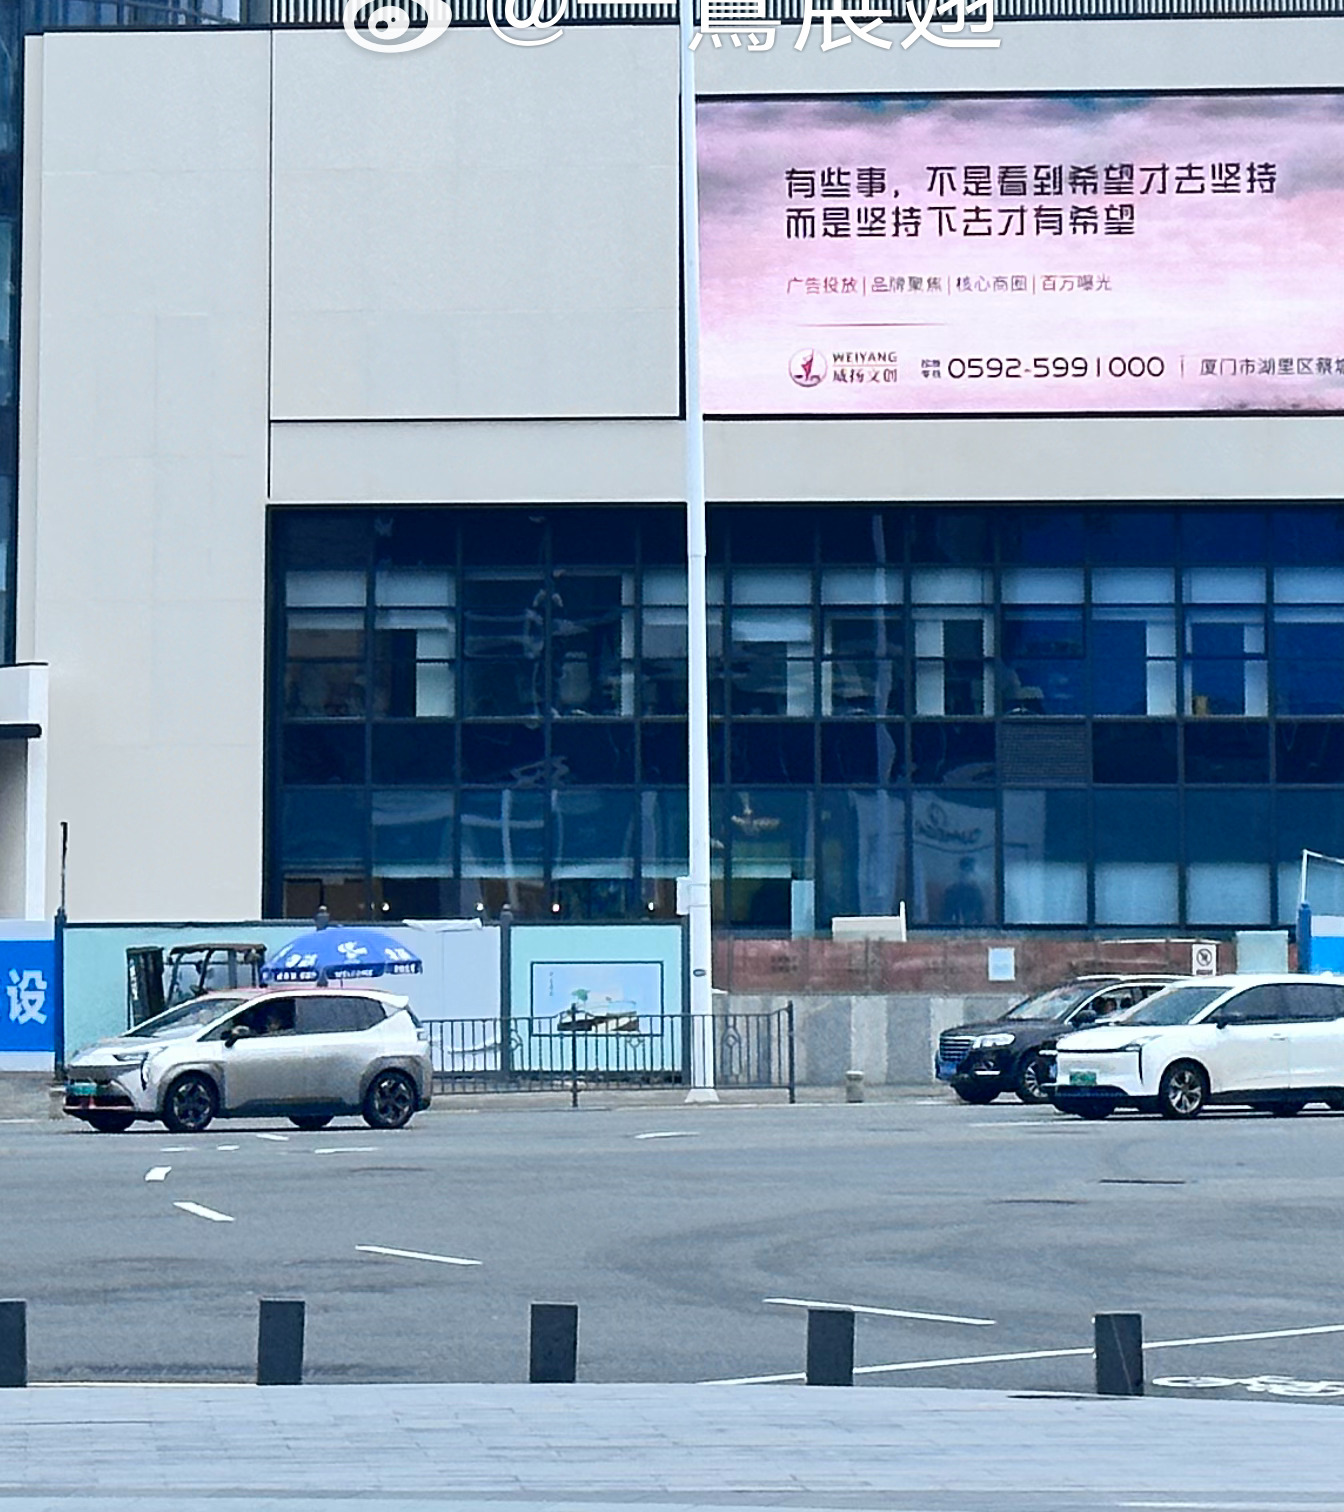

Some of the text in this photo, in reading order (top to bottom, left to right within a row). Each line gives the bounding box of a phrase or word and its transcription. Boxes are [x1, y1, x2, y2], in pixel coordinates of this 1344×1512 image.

[785, 162, 1277, 199] 有些事，不是看到希望才去坚持
[786, 204, 1136, 239] 而是坚持下去才有希望
[832, 351, 898, 363] WEIYANG
[947, 356, 1164, 378] 0592-5991000
